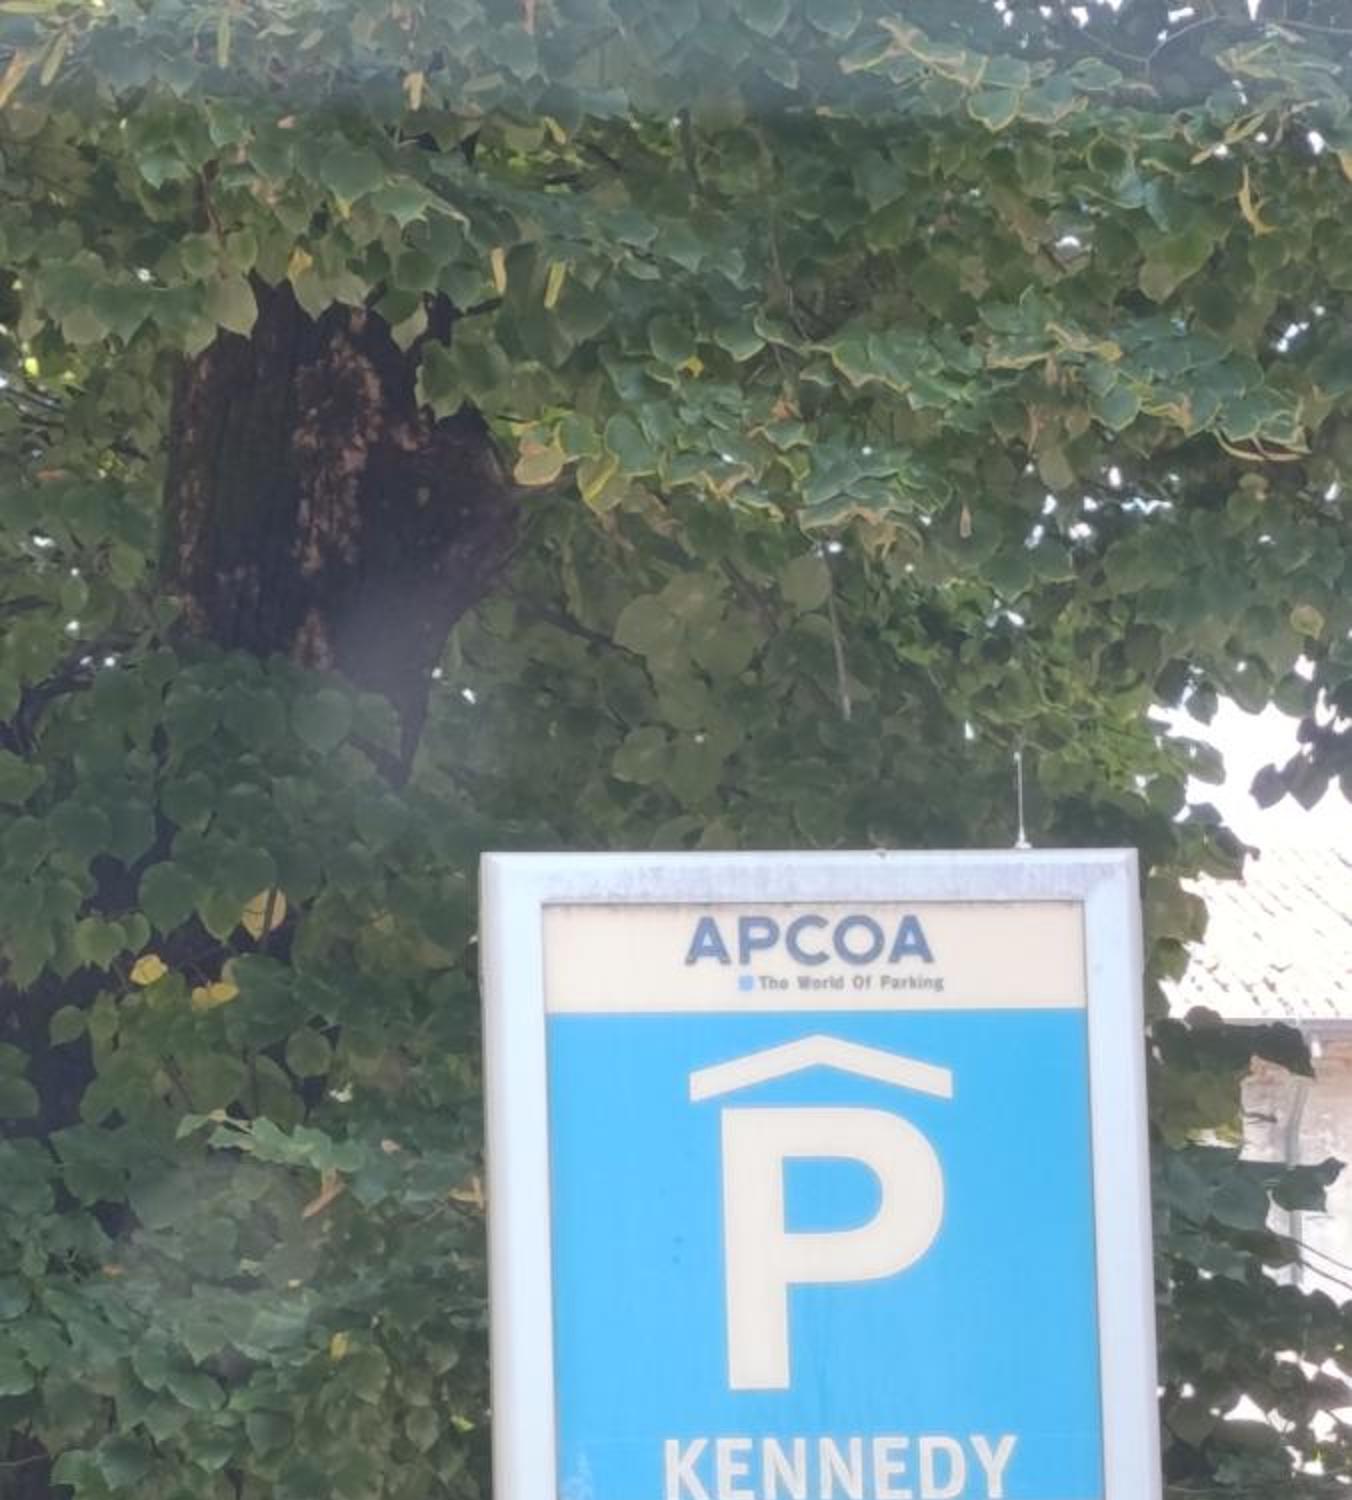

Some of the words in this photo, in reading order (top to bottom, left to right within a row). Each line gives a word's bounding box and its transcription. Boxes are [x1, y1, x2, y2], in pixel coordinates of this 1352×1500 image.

[684, 914, 935, 966] APCOA
[759, 975, 789, 991] The
[797, 975, 845, 991] World
[853, 974, 873, 991] Of
[881, 974, 944, 993] Parking
[721, 1107, 944, 1390] P
